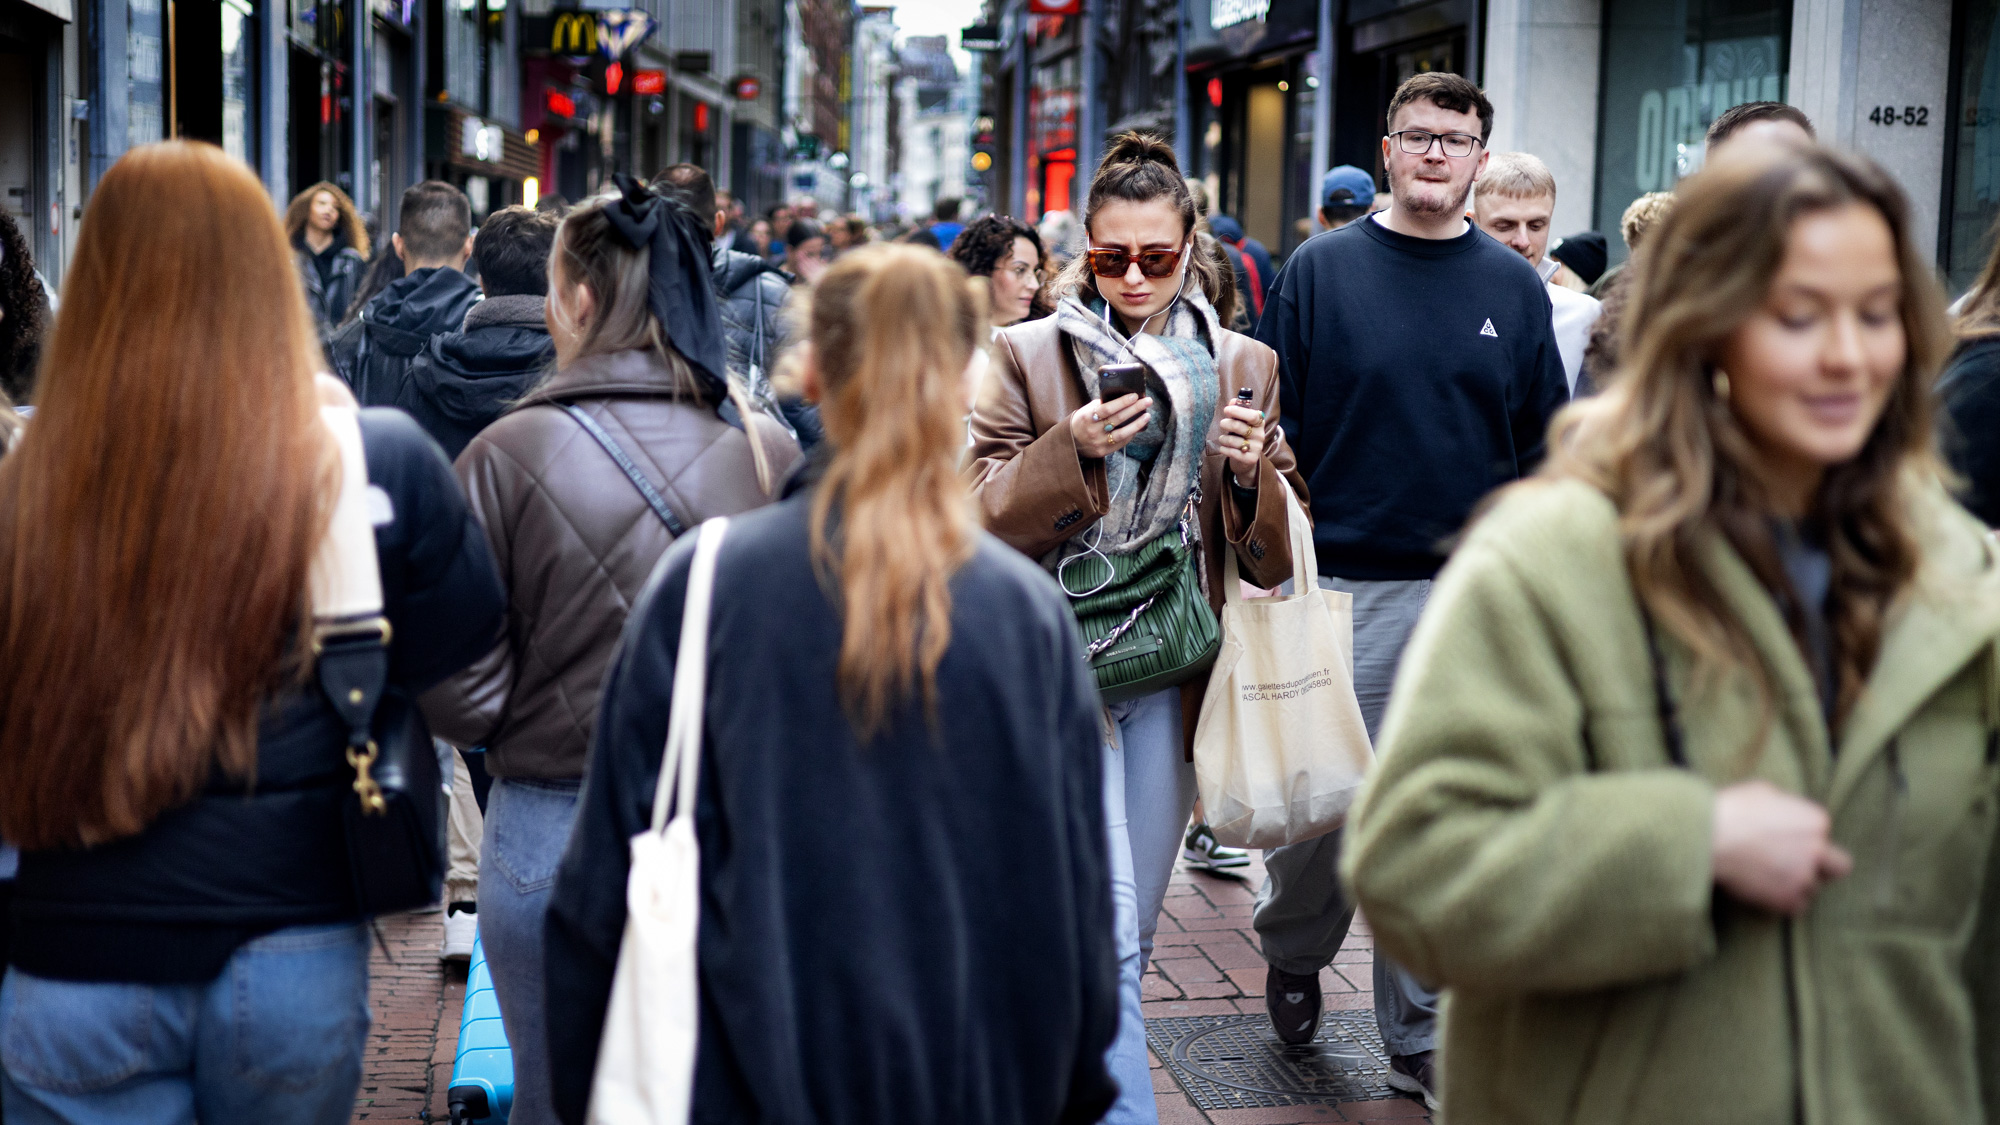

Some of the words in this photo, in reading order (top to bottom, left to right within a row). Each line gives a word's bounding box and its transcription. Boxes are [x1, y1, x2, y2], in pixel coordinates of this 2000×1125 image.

[1869, 105, 1929, 126] 48-52
[1242, 692, 1270, 701] ASCAL
[1271, 689, 1300, 700] HARDY
